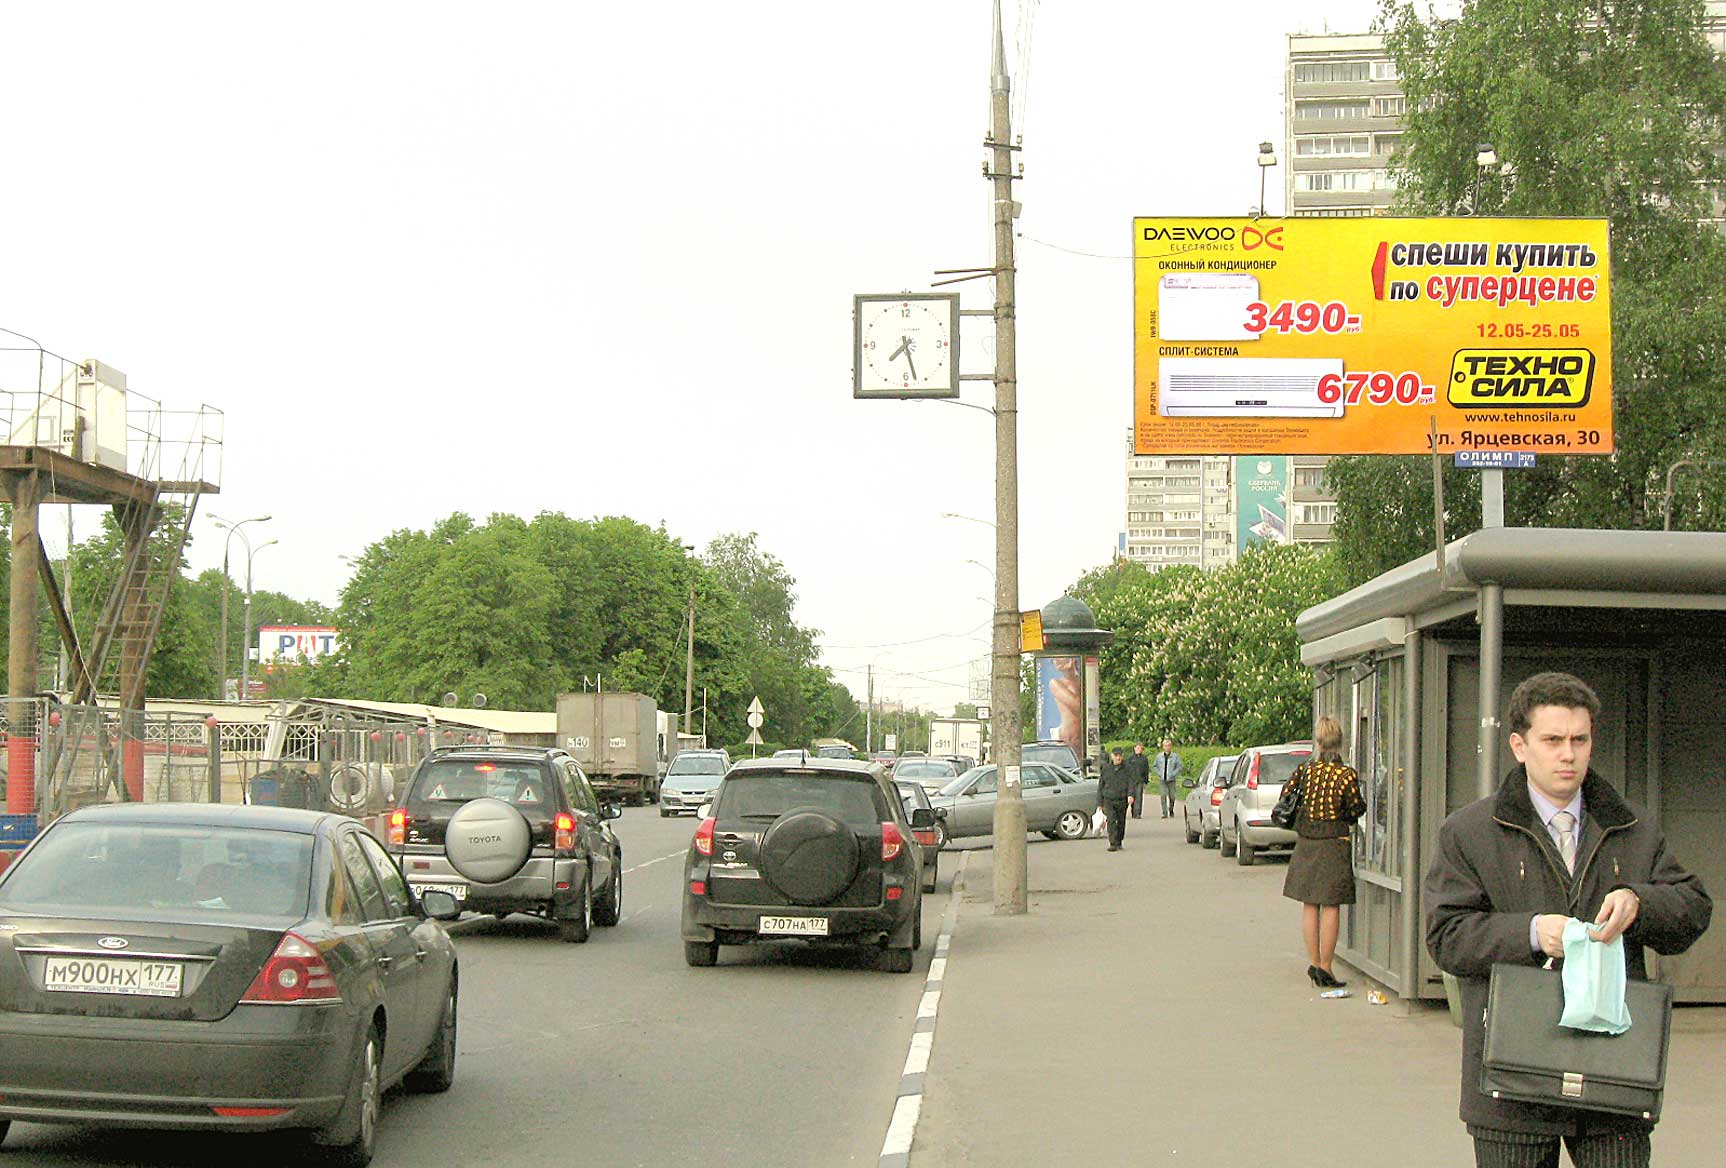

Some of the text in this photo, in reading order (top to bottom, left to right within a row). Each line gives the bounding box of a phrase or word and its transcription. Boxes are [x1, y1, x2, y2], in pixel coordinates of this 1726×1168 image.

[1144, 227, 1235, 240] DAEWOO
[1170, 243, 1235, 251] ELECTRONICS
[1390, 242, 1596, 273] спеши купить
[1158, 259, 1277, 271] ОКОННЫЙ КОНДИЦИОНЕР
[1390, 281, 1419, 300] по
[901, 309, 911, 318] 12
[1477, 323, 1580, 338] 12.05-25.05
[870, 340, 942, 350] 9 3
[1159, 346, 1239, 356] СПЛИТ-СИСТЕМА
[1464, 356, 1583, 375] ТЕХНО
[903, 372, 909, 381] 6
[1465, 411, 1576, 423] www.tehnosila.ru
[1427, 430, 1600, 449] ул. Ярцевская, 30
[1460, 452, 1513, 461] ОЛИМП
[468, 835, 502, 844] TOYOTA
[763, 918, 825, 931] С707НА 177
[51, 961, 177, 986] М900НХ 177
